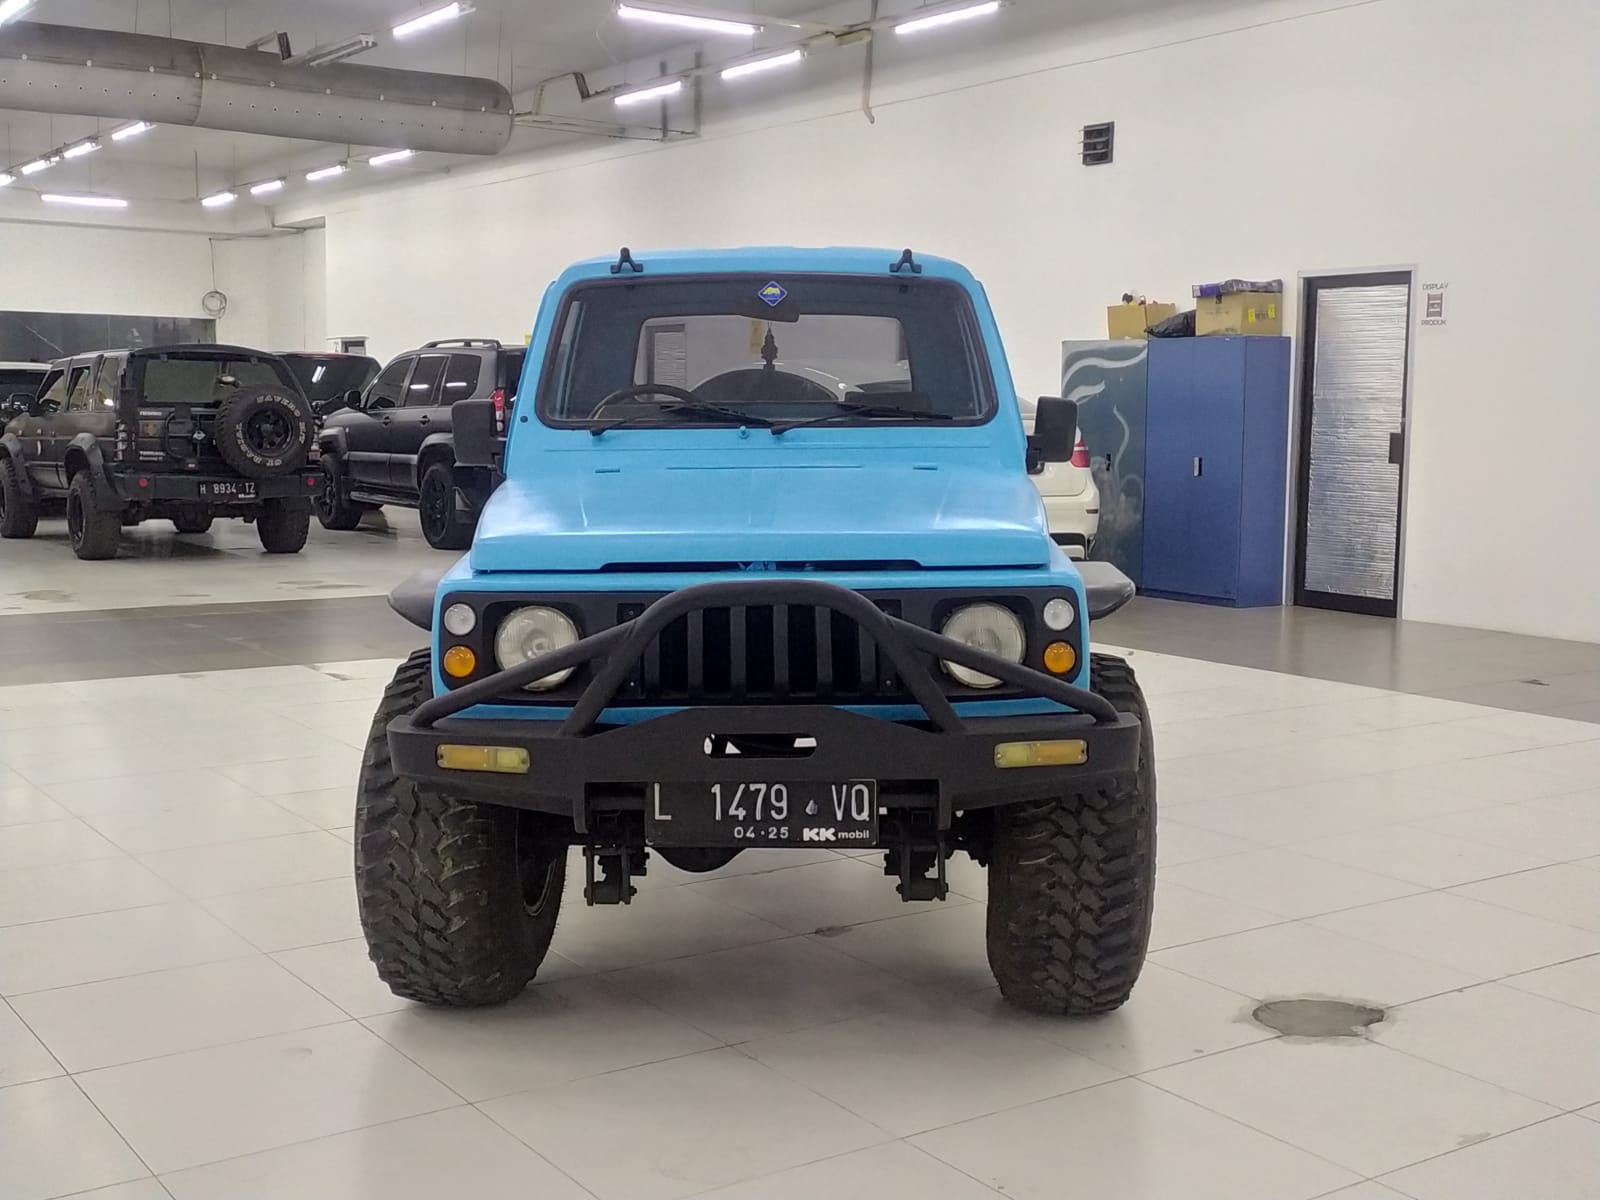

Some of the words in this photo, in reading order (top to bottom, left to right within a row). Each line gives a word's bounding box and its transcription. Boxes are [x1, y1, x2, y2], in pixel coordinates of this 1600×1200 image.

[1422, 282, 1449, 290] DISPLAY
[200, 484, 206, 494] H
[213, 483, 237, 494] 8934
[245, 482, 256, 493] TZ
[654, 782, 672, 820] L
[711, 783, 788, 821] 1479
[832, 784, 870, 821] VQ
[803, 827, 837, 841] KK
[838, 829, 870, 839] mobil
